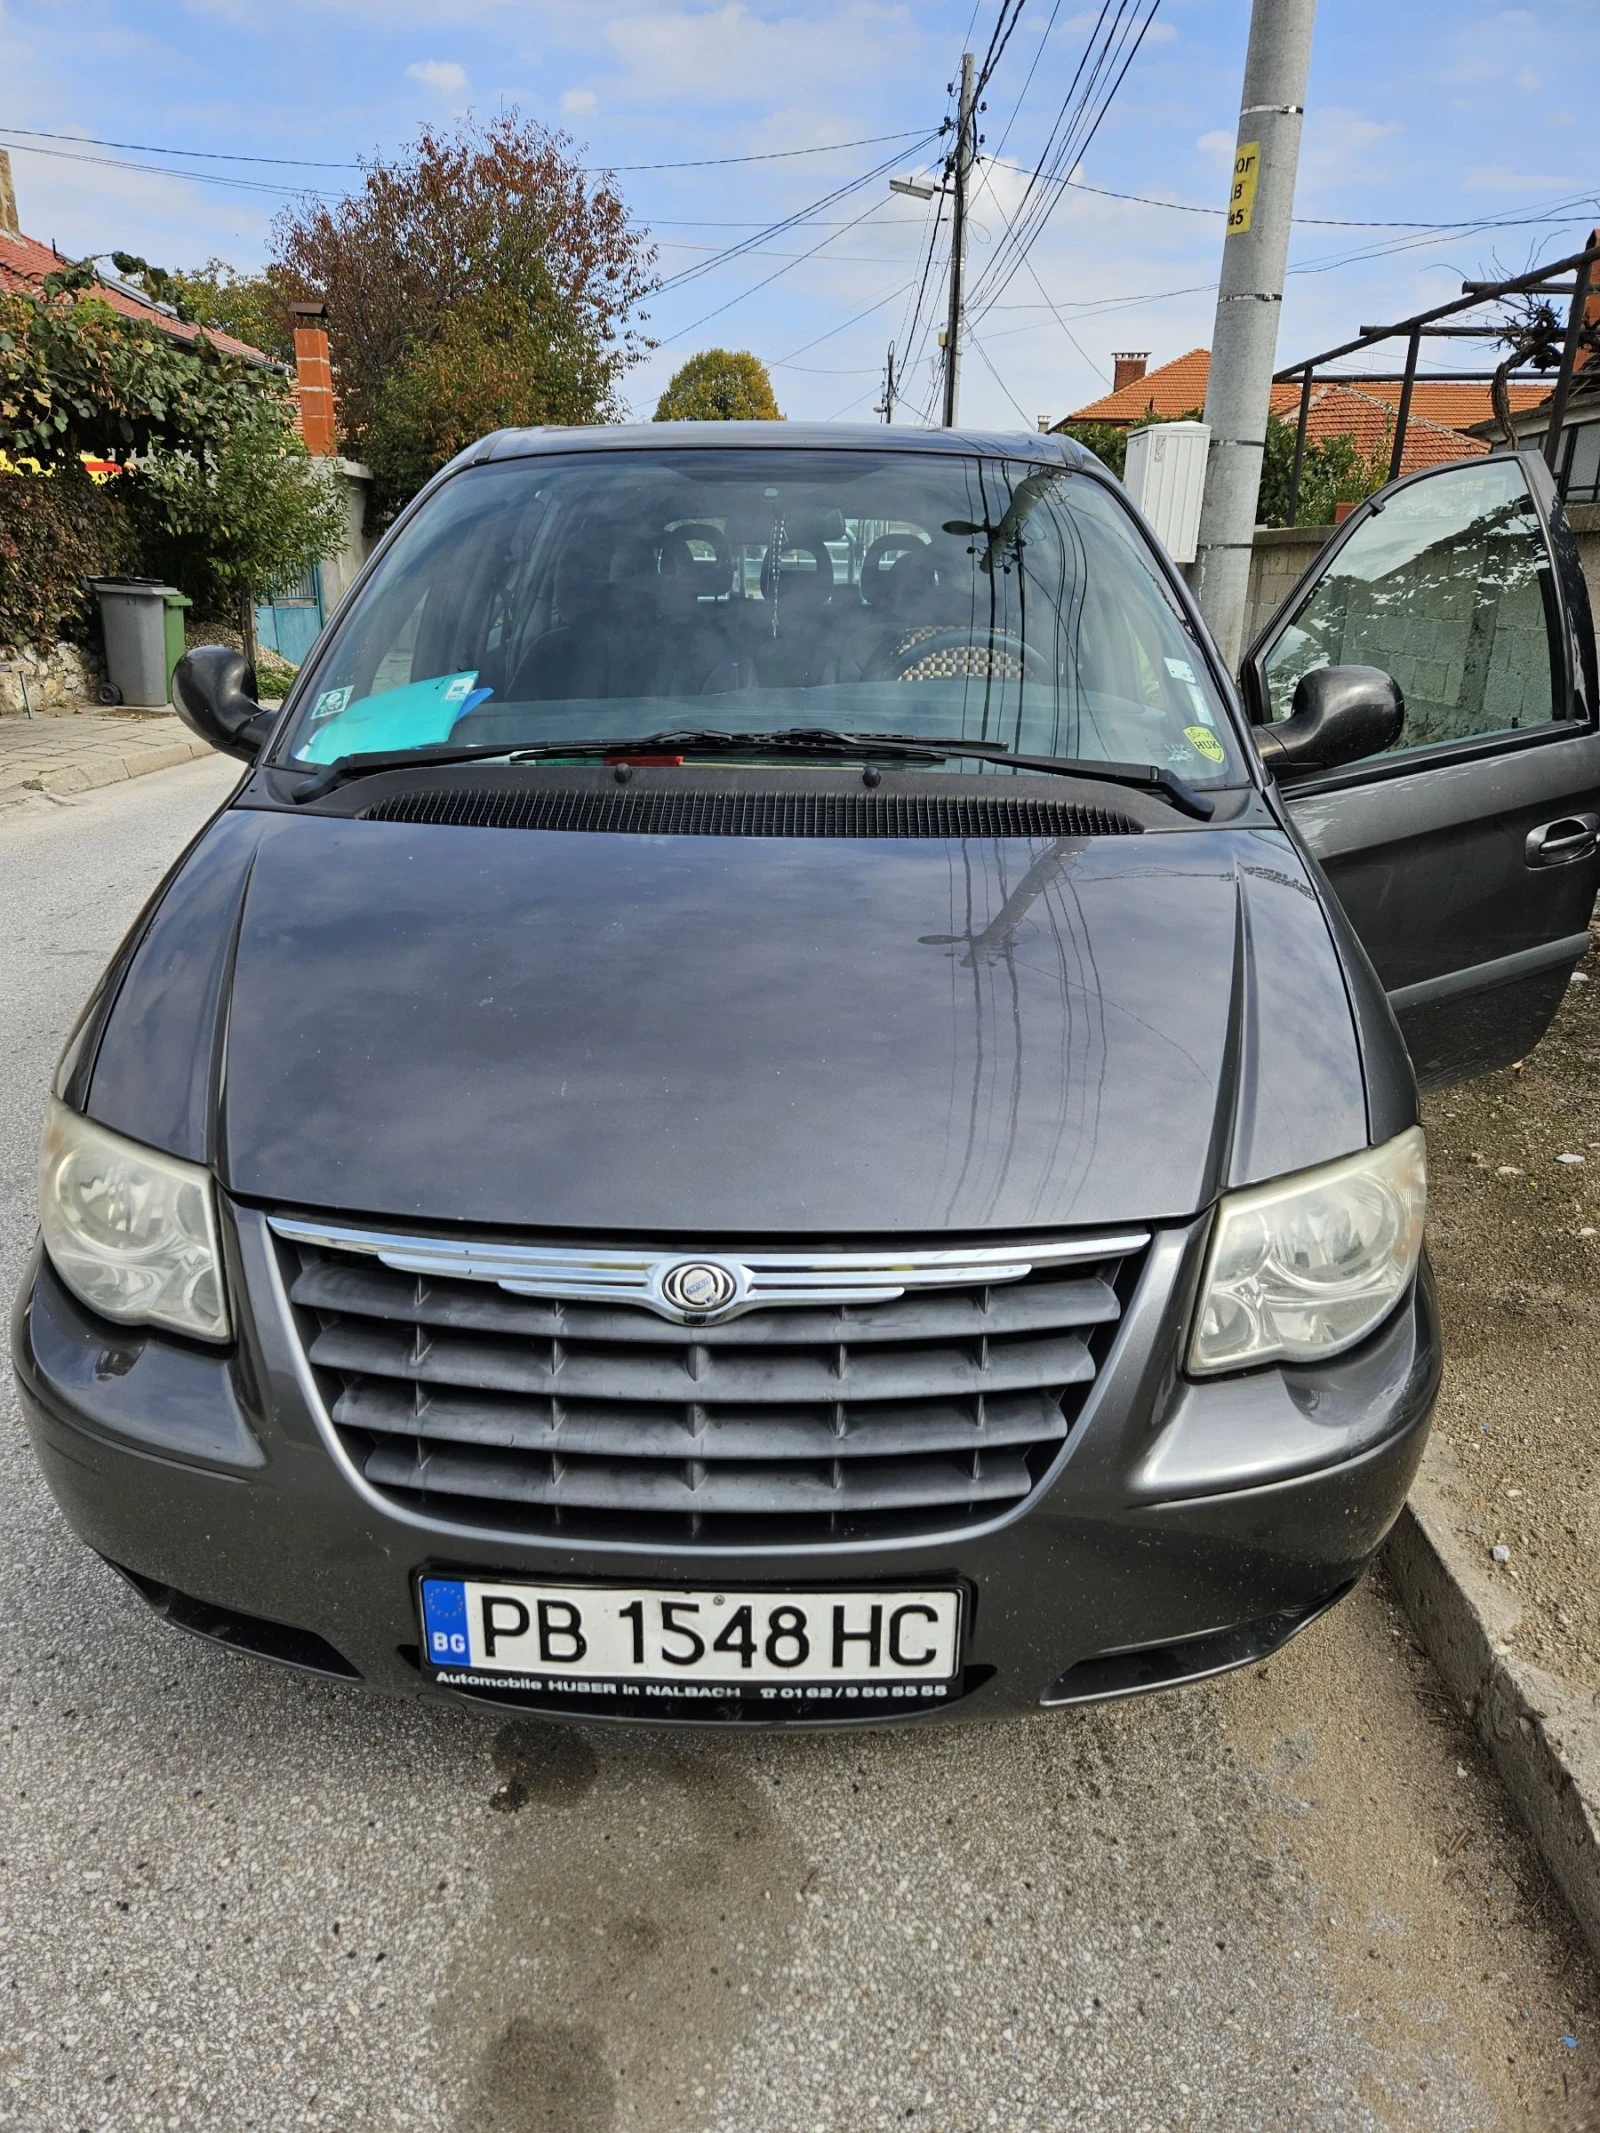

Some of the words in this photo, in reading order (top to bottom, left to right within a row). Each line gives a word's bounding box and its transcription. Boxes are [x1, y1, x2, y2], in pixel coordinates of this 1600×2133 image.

[1193, 740, 1221, 750] HUK
[432, 1631, 466, 1654] BG
[618, 1600, 810, 1668] 1548
[831, 1604, 939, 1668] HC
[435, 1671, 543, 1690] Automobile
[548, 1680, 617, 1695] HUBER
[622, 1683, 640, 1696] in
[645, 1684, 742, 1698] NALBACH
